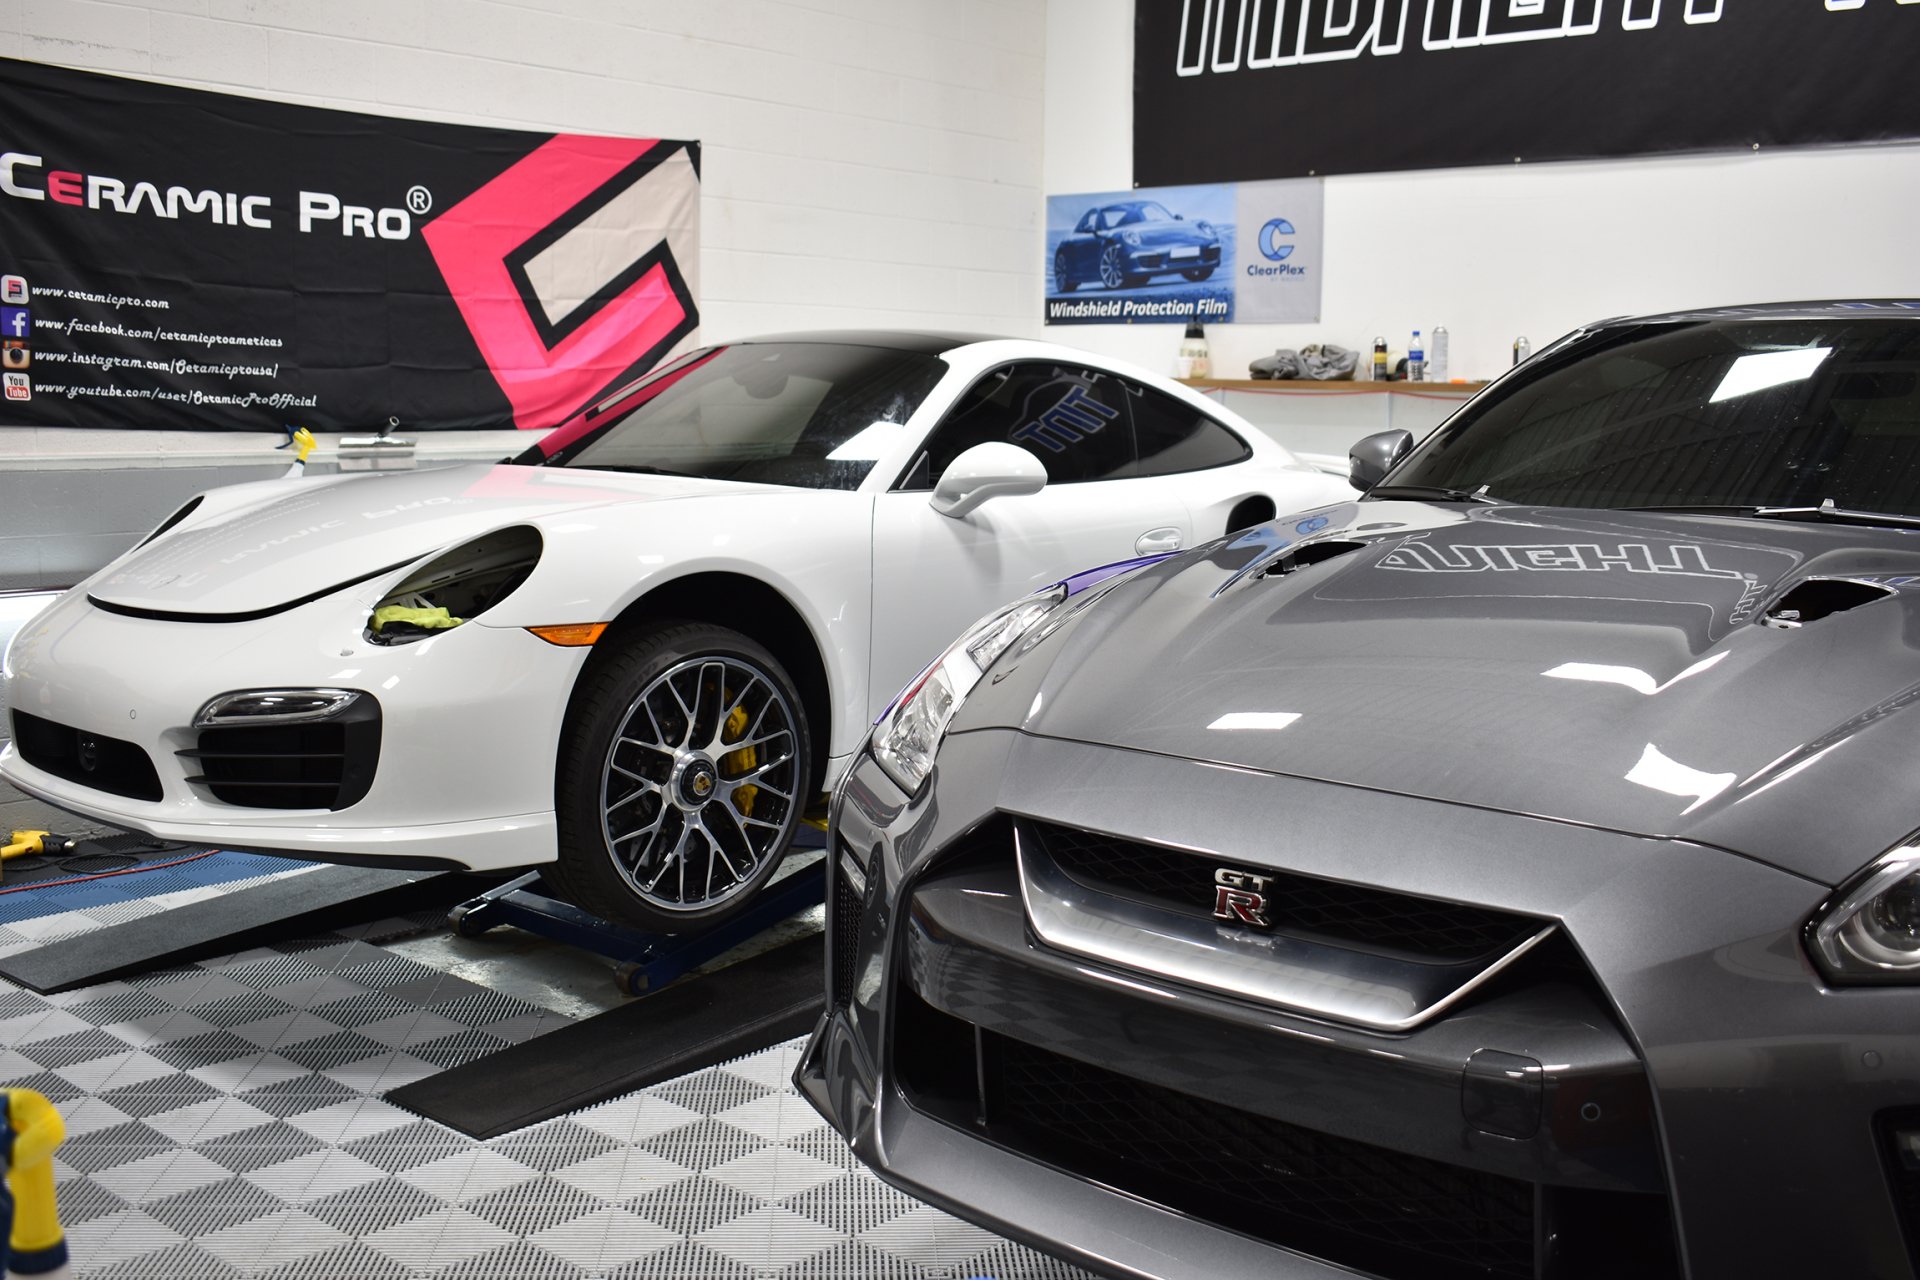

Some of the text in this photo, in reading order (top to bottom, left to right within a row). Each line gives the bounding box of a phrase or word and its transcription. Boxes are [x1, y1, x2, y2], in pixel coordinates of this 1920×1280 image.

[1247, 264, 1305, 276] ClearPlex
[32, 286, 169, 309] www.ceramicpro.com
[1050, 298, 1228, 318] Windshield Protection Film
[35, 318, 283, 348] www.facebook.com/ceramicproamericas
[8, 376, 24, 386] You
[8, 387, 27, 398] Tube
[35, 384, 317, 409] www.youtube.com/user/CeramicProOfficial
